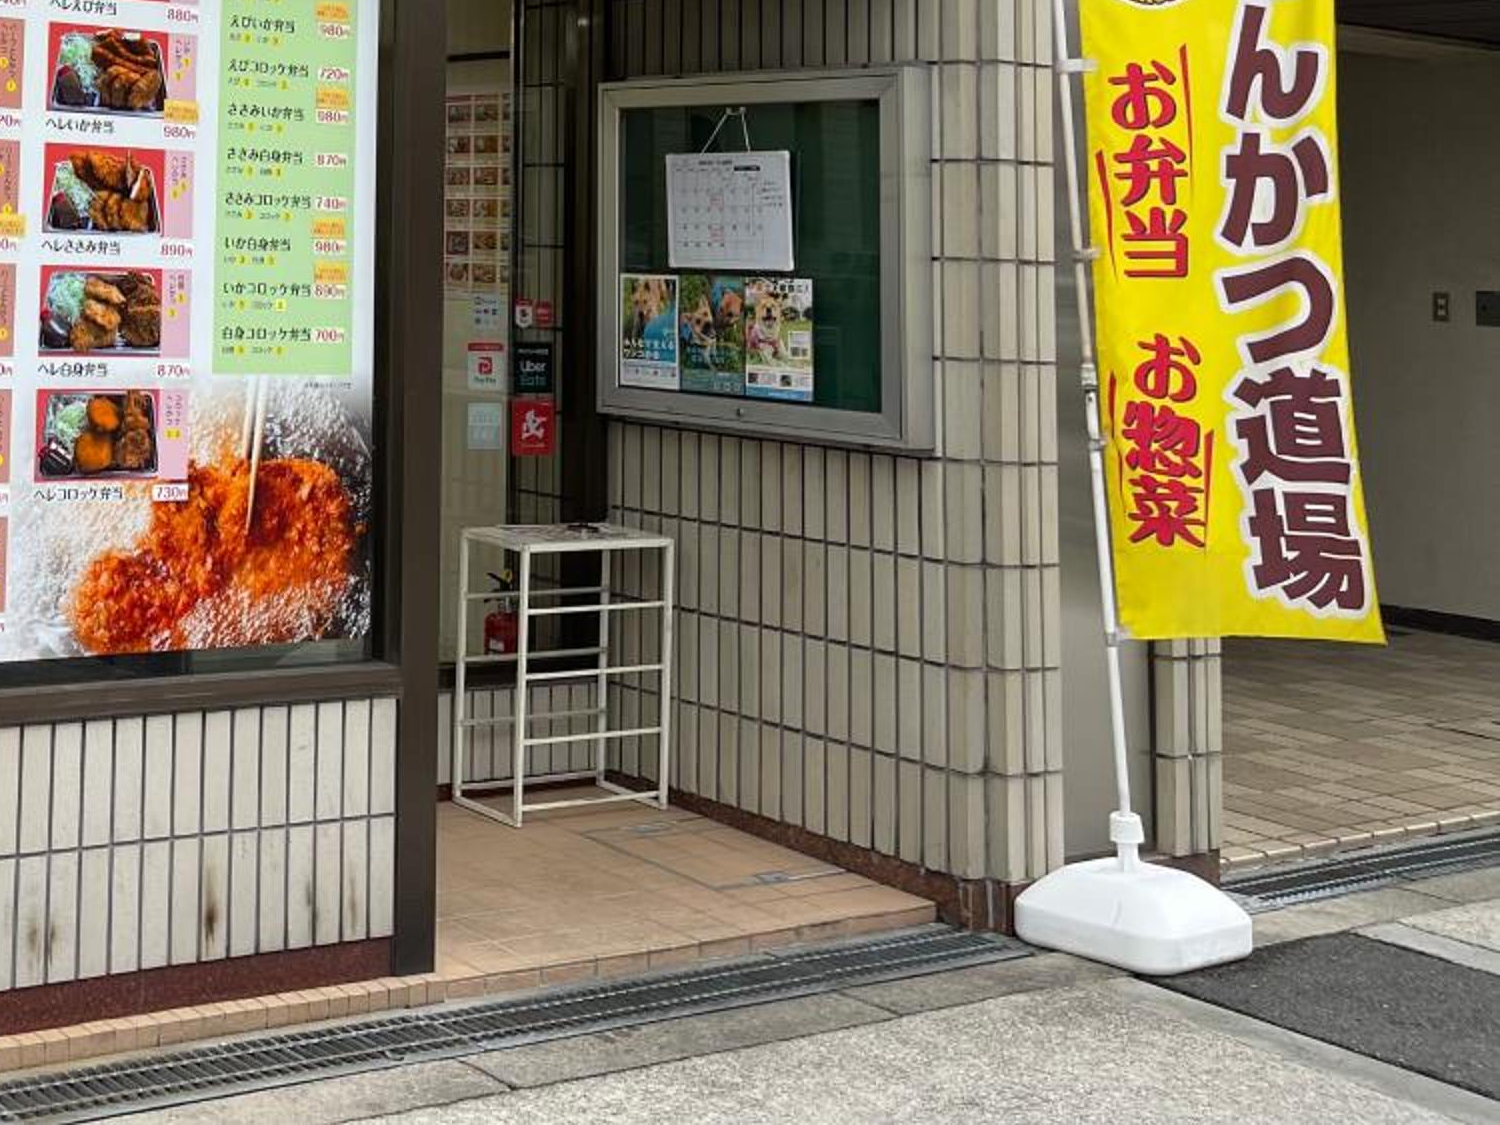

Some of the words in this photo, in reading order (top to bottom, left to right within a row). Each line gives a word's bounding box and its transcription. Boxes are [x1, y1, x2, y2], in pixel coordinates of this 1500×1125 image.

[1110, 59, 1190, 281] お弁当
[1120, 333, 1206, 551] お惣菜
